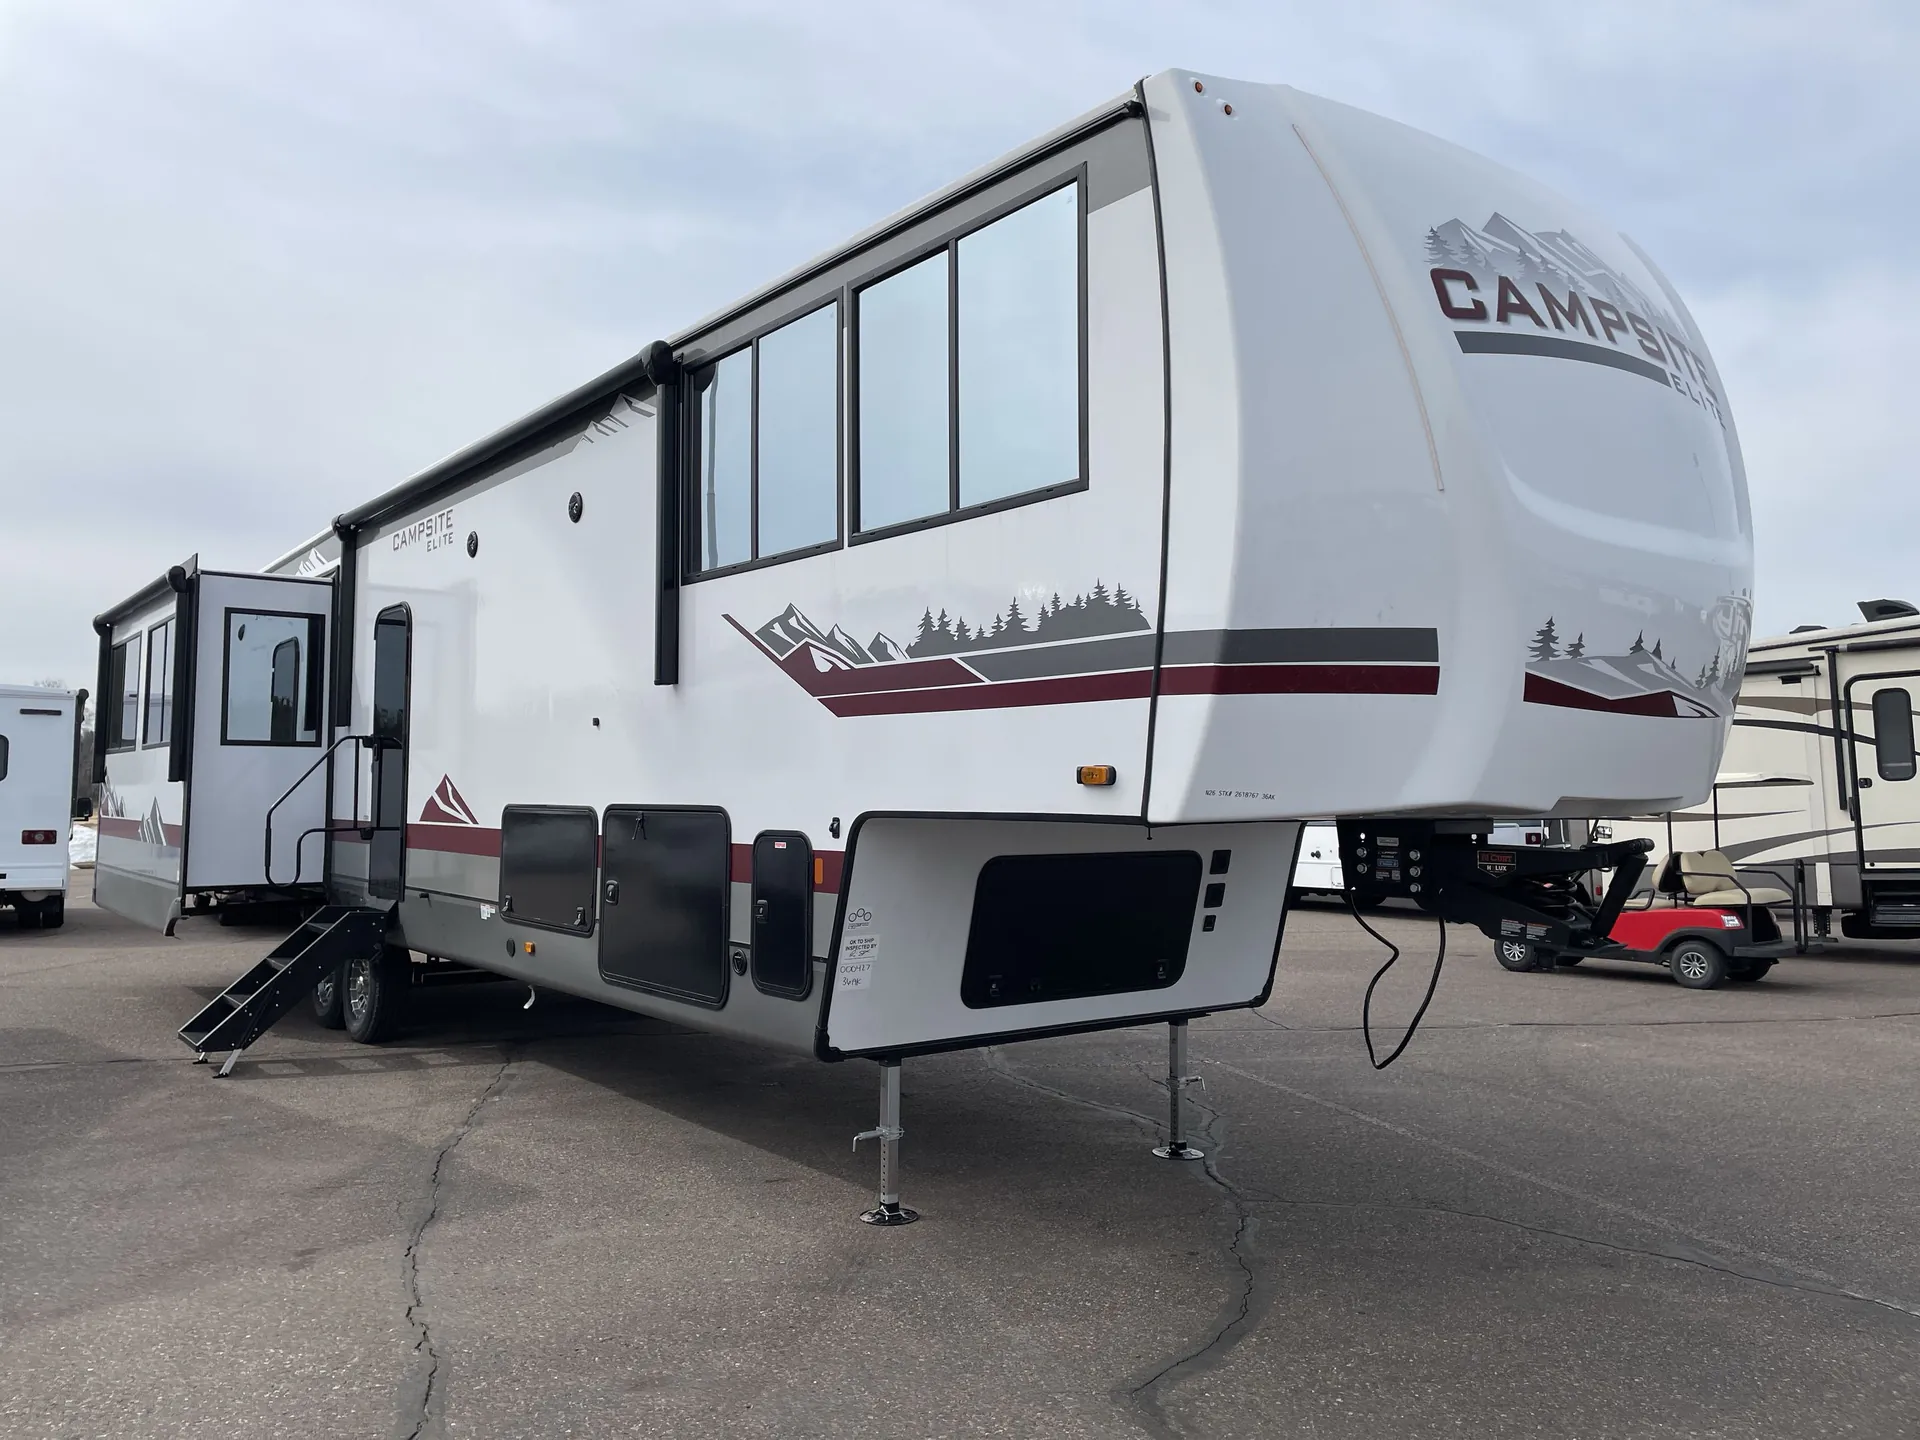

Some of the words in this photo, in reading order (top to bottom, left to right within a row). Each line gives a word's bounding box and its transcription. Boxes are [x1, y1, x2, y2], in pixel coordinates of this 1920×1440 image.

[1430, 267, 1718, 403] CAMPSITE
[1670, 372, 1727, 431] ELITE
[392, 509, 454, 552] CAMPSITE
[426, 531, 454, 553] ELITE
